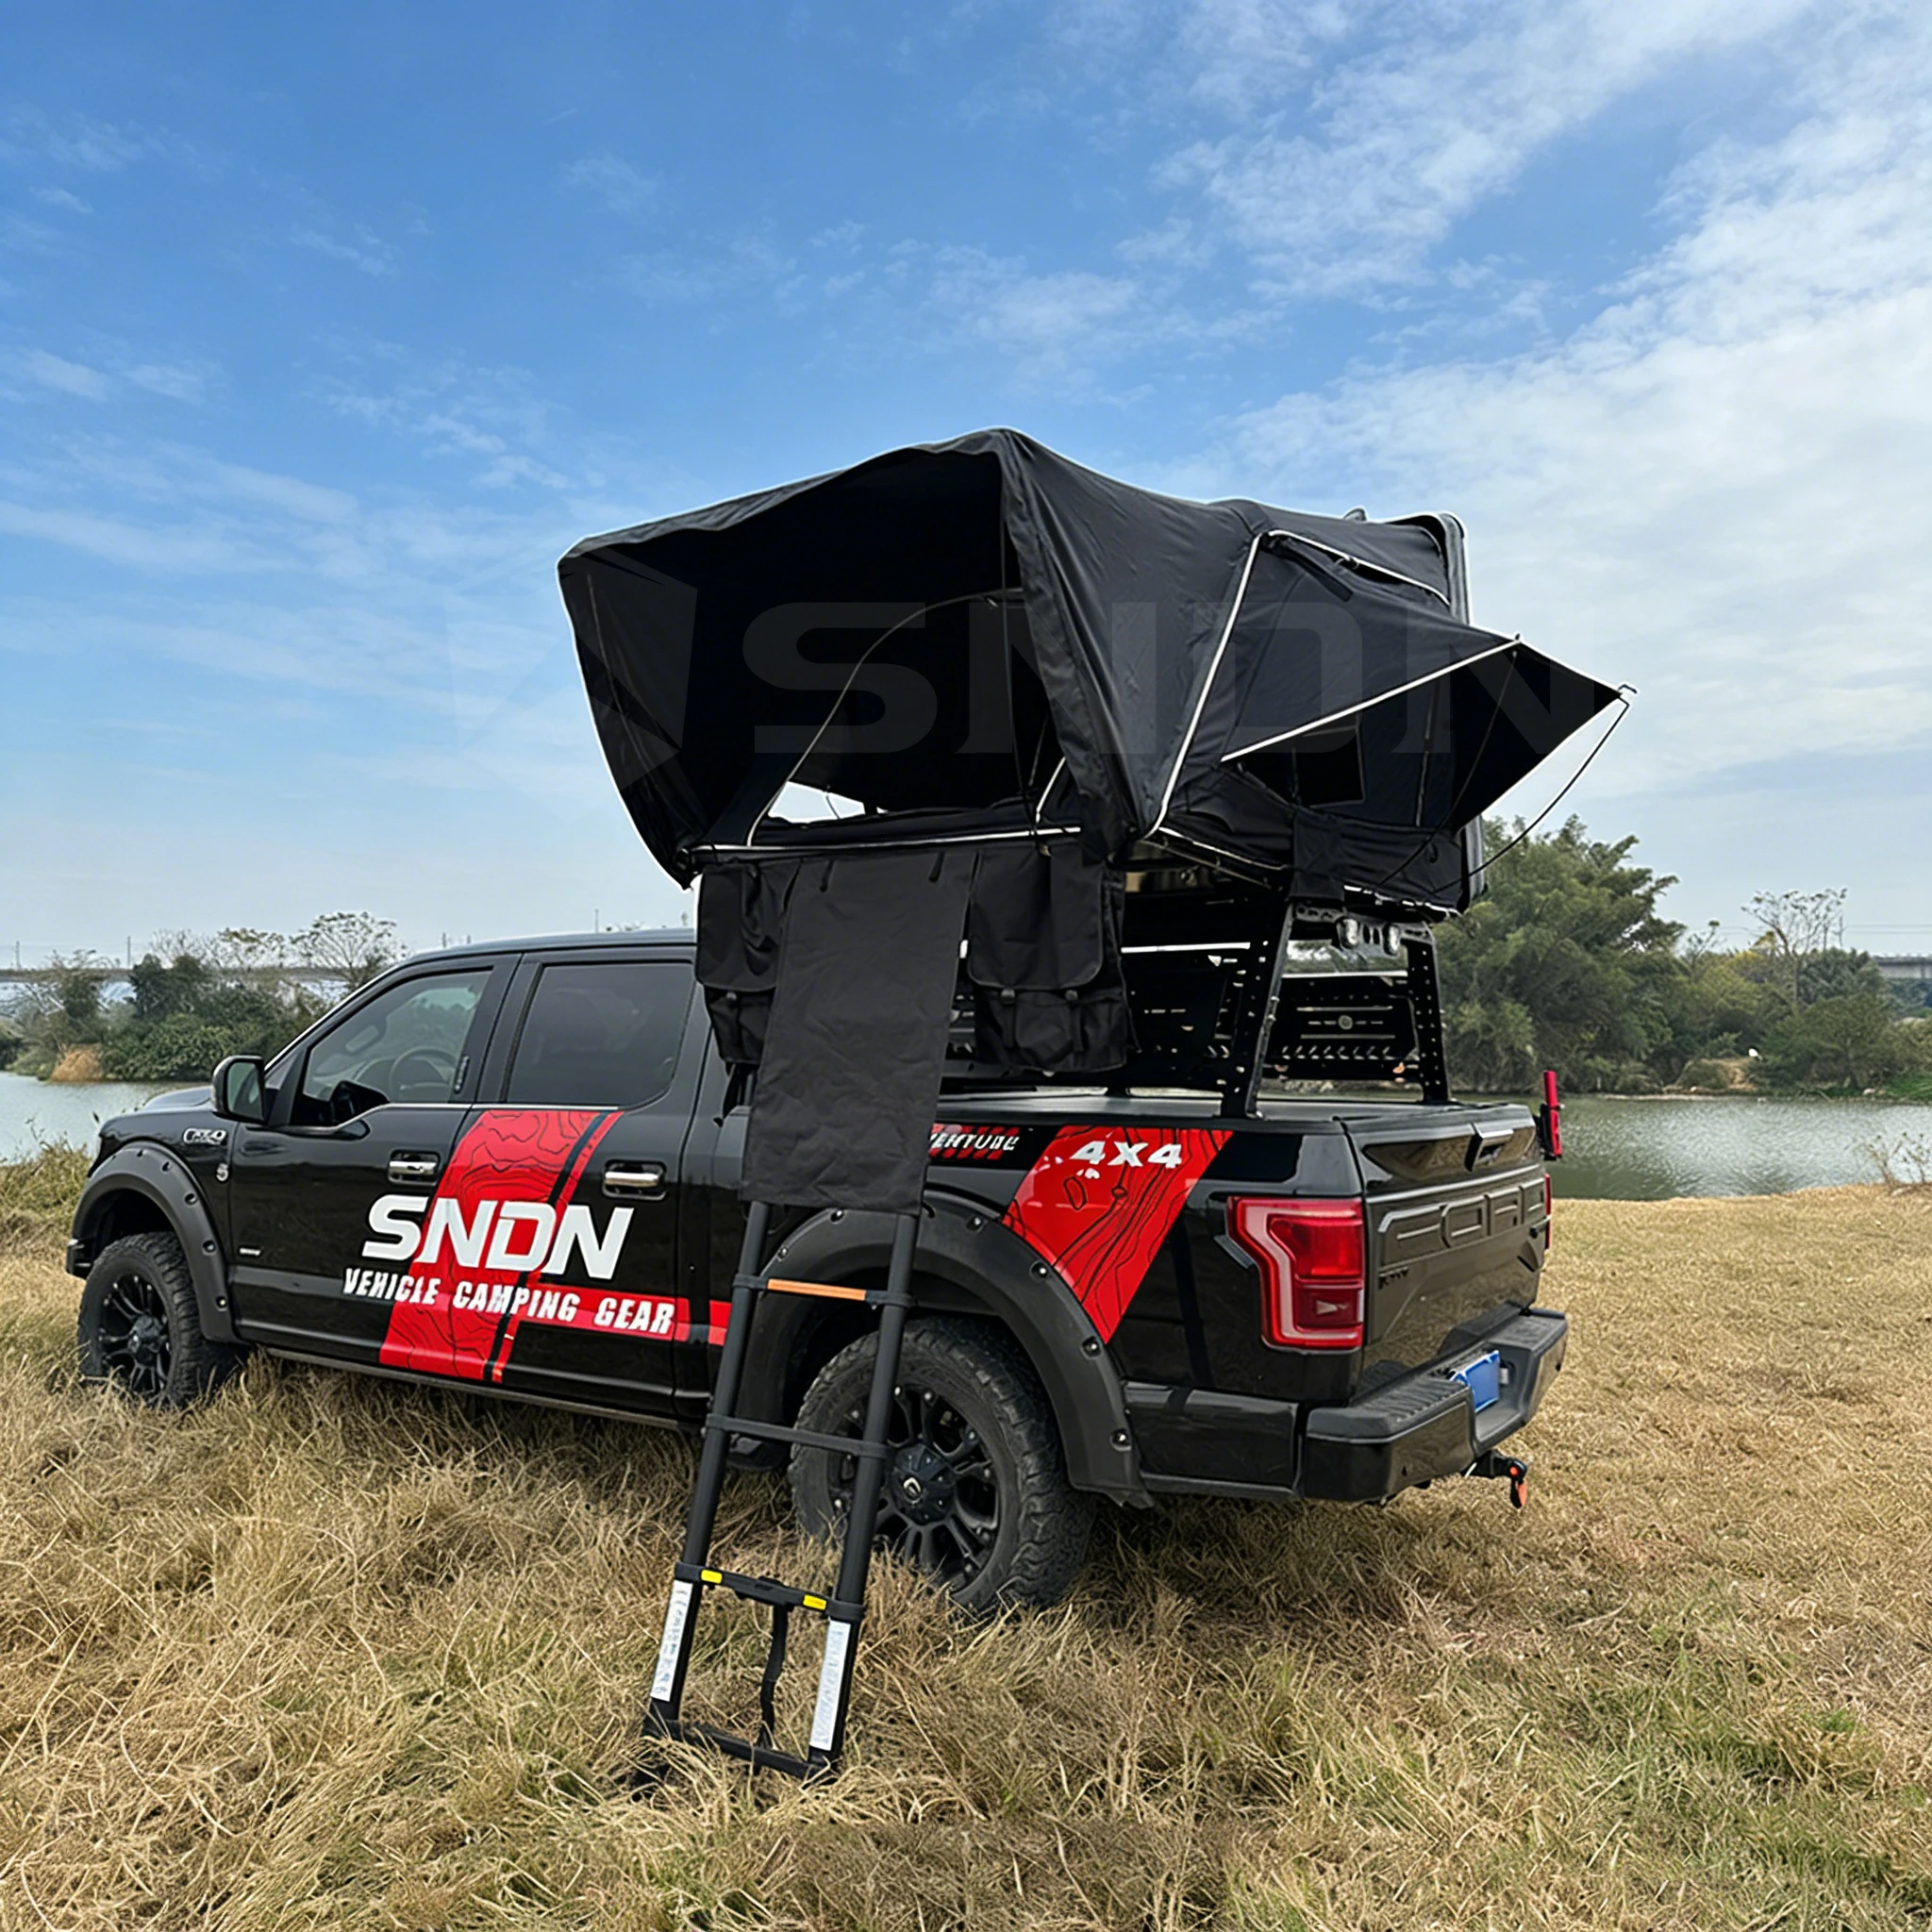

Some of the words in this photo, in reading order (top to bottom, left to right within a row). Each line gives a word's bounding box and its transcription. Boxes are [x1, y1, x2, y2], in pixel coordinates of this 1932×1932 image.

[1070, 1141, 1182, 1168] 4X4
[362, 1194, 634, 1279] SNDN
[342, 1268, 441, 1304] VEHICLE
[453, 1280, 580, 1322] CAMPING
[593, 1297, 675, 1334] GEAR
